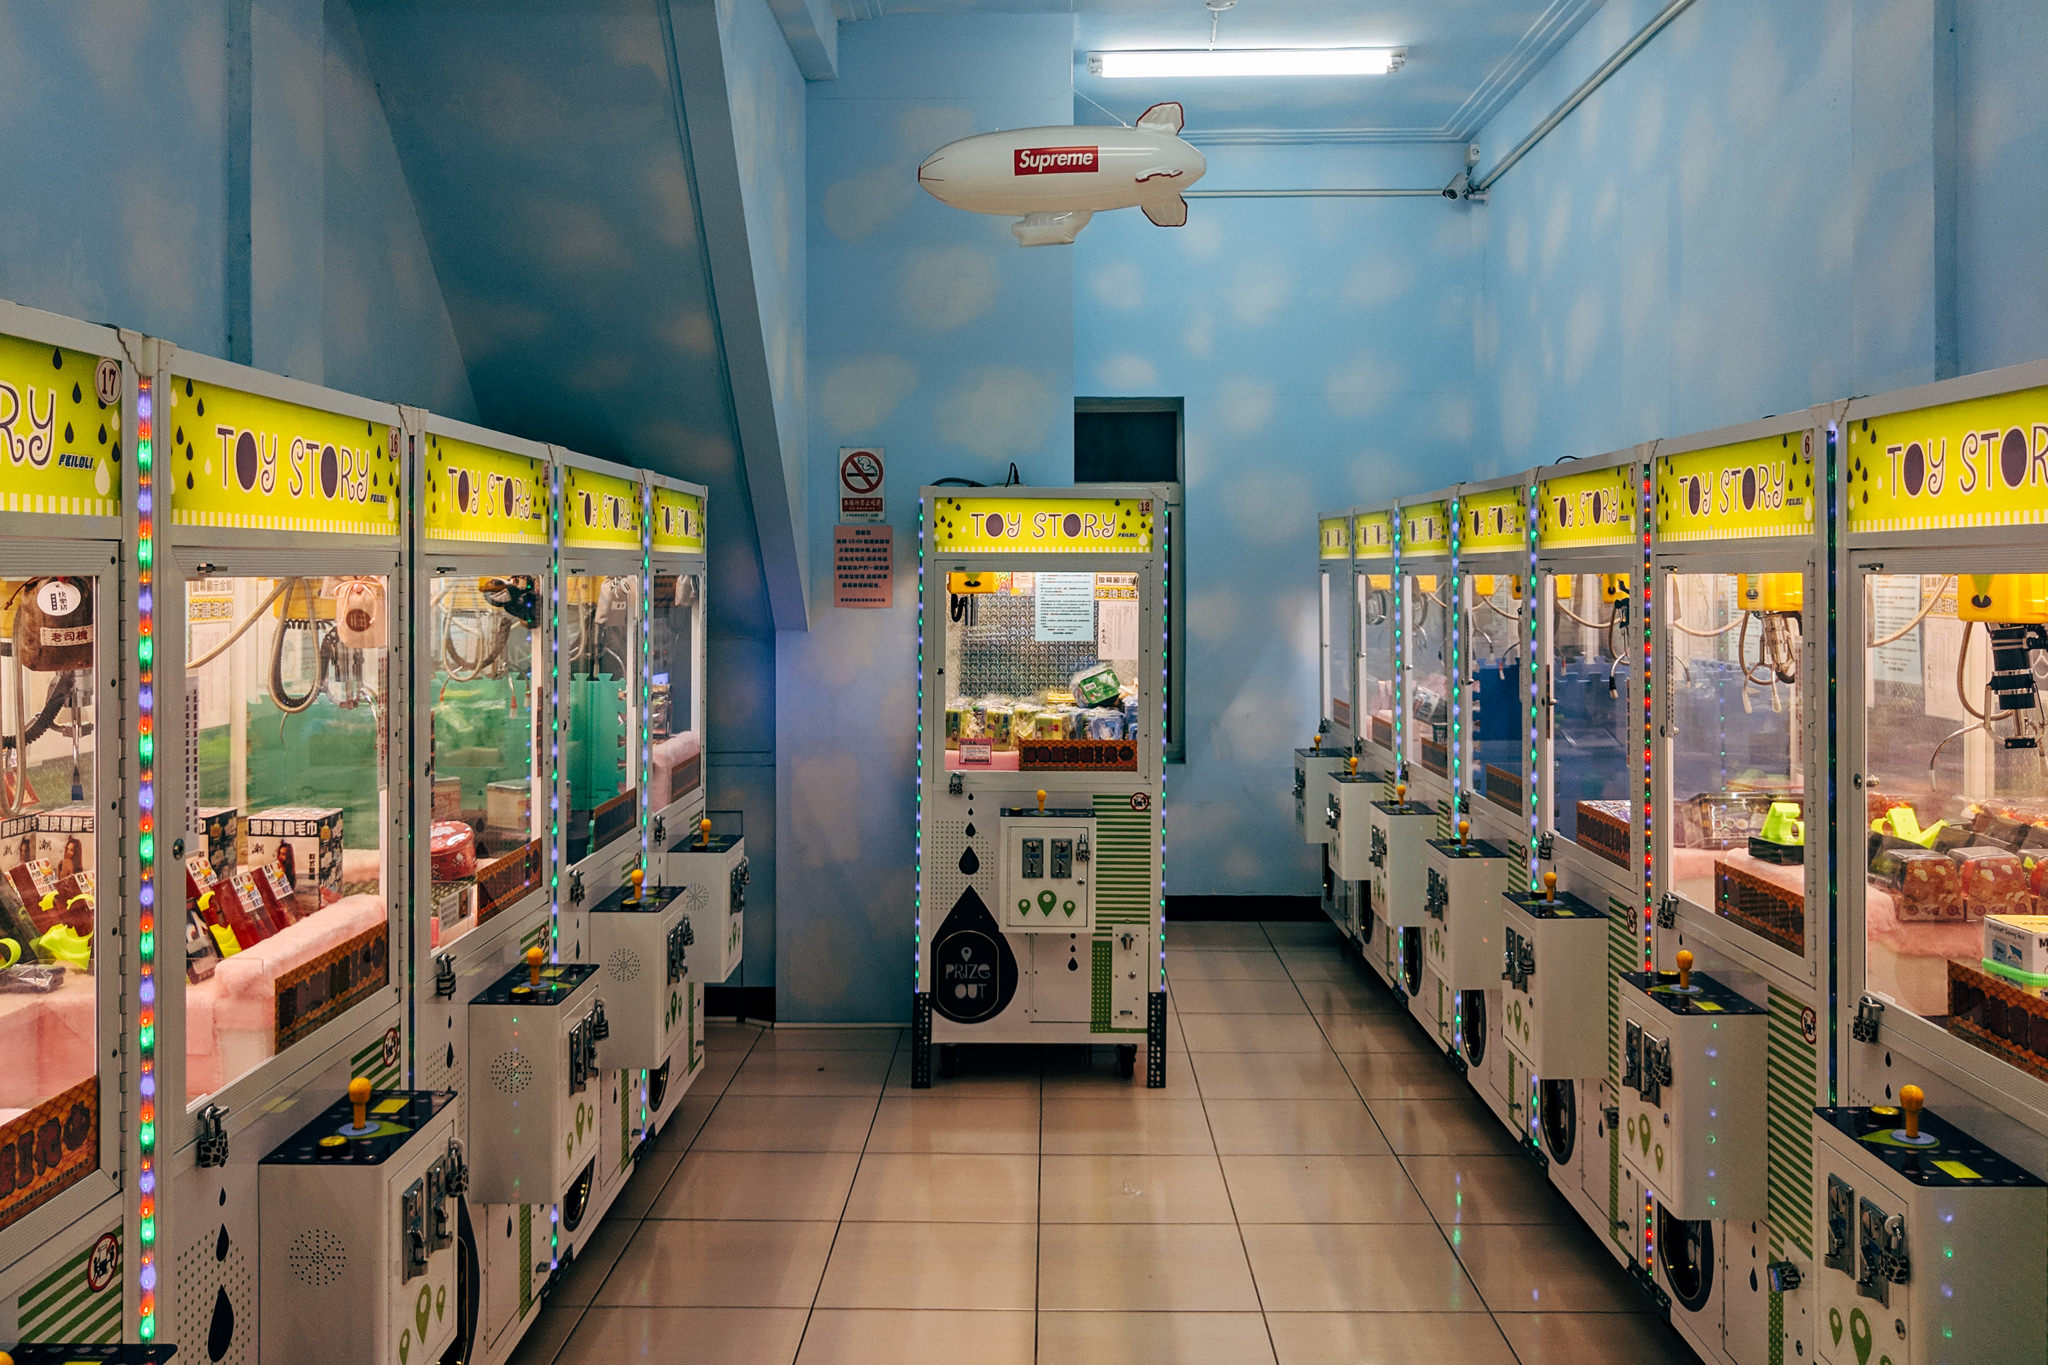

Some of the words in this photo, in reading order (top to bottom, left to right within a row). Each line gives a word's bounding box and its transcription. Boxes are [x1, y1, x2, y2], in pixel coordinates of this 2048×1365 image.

[1019, 150, 1094, 172] Supreme
[101, 367, 117, 397] 17
[58, 453, 94, 471] FEILOLI
[216, 424, 278, 496] TOY
[288, 435, 370, 505] STORY
[1886, 437, 1946, 498] TOY
[447, 467, 482, 516] TOY
[486, 472, 533, 521] STORY
[1553, 496, 1574, 528] TOY
[1578, 486, 1619, 528] STORY
[1679, 472, 1713, 518] TOY
[1719, 461, 1787, 516] STORY
[578, 490, 599, 528] TOY
[602, 493, 631, 532] STORY
[970, 512, 1021, 538] TOY
[1032, 512, 1117, 539] STORY
[51, 630, 88, 643] 老司機
[954, 983, 987, 1000] OUT
